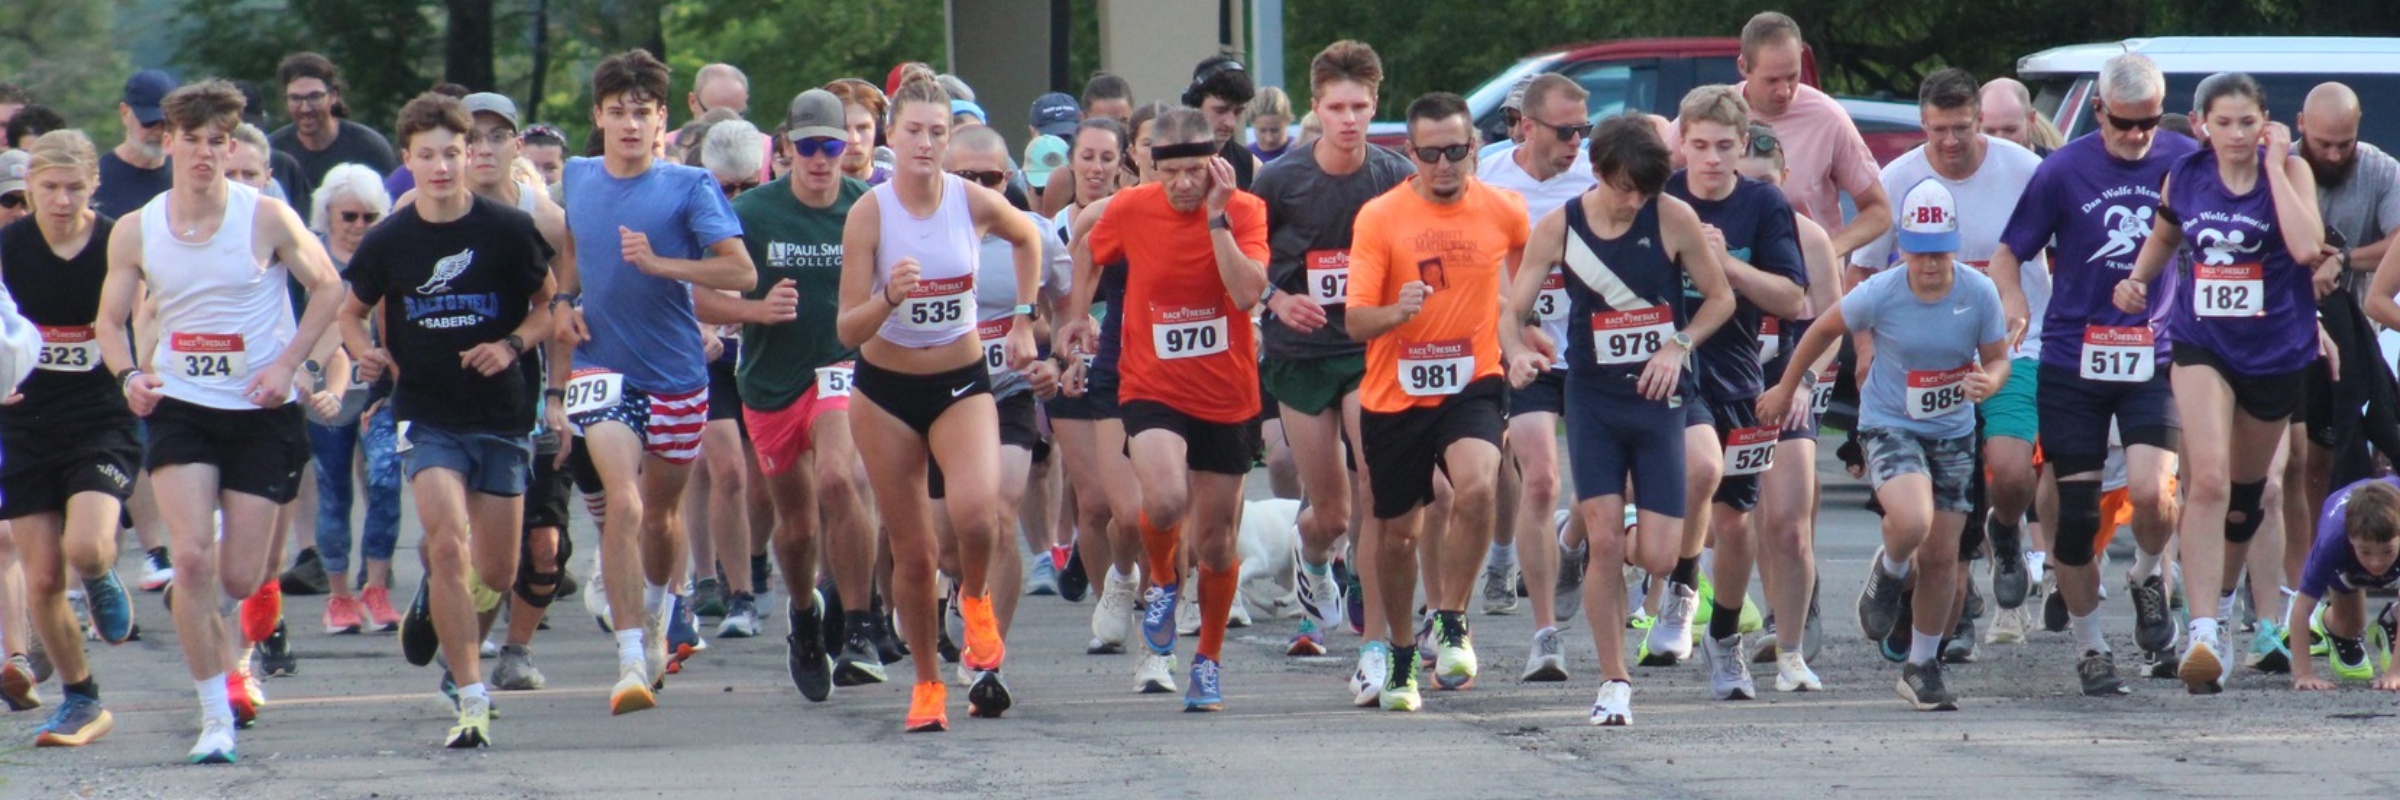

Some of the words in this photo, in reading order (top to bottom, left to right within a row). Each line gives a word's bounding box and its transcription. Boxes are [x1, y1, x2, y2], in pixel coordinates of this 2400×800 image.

[2081, 198, 2102, 214] Dan
[2102, 185, 2132, 199] Wolfe
[1916, 206, 1943, 223] BR
[2182, 217, 2199, 232] Dan
[2200, 211, 2229, 222] Wolfe
[2230, 213, 2270, 232] Memorial
[786, 243, 819, 256] PAUL
[937, 281, 964, 291] RESULT
[2203, 285, 2248, 309] 182
[424, 314, 476, 328] SABERS
[911, 299, 961, 324] 535
[1162, 311, 1181, 319] RACE
[1189, 307, 1216, 317] RESULT
[1605, 316, 1624, 324] RACE
[1633, 312, 1660, 321] RESULT
[1166, 325, 1216, 352] 970
[1408, 347, 1427, 355] RACE
[1435, 344, 1462, 354] RESULT
[1609, 330, 1661, 357] 978
[39, 346, 88, 366] 523
[185, 355, 231, 377] 324
[2091, 351, 2140, 375] 517
[1411, 363, 1458, 389] 981
[566, 379, 608, 407] 979
[1921, 385, 1966, 412] 989
